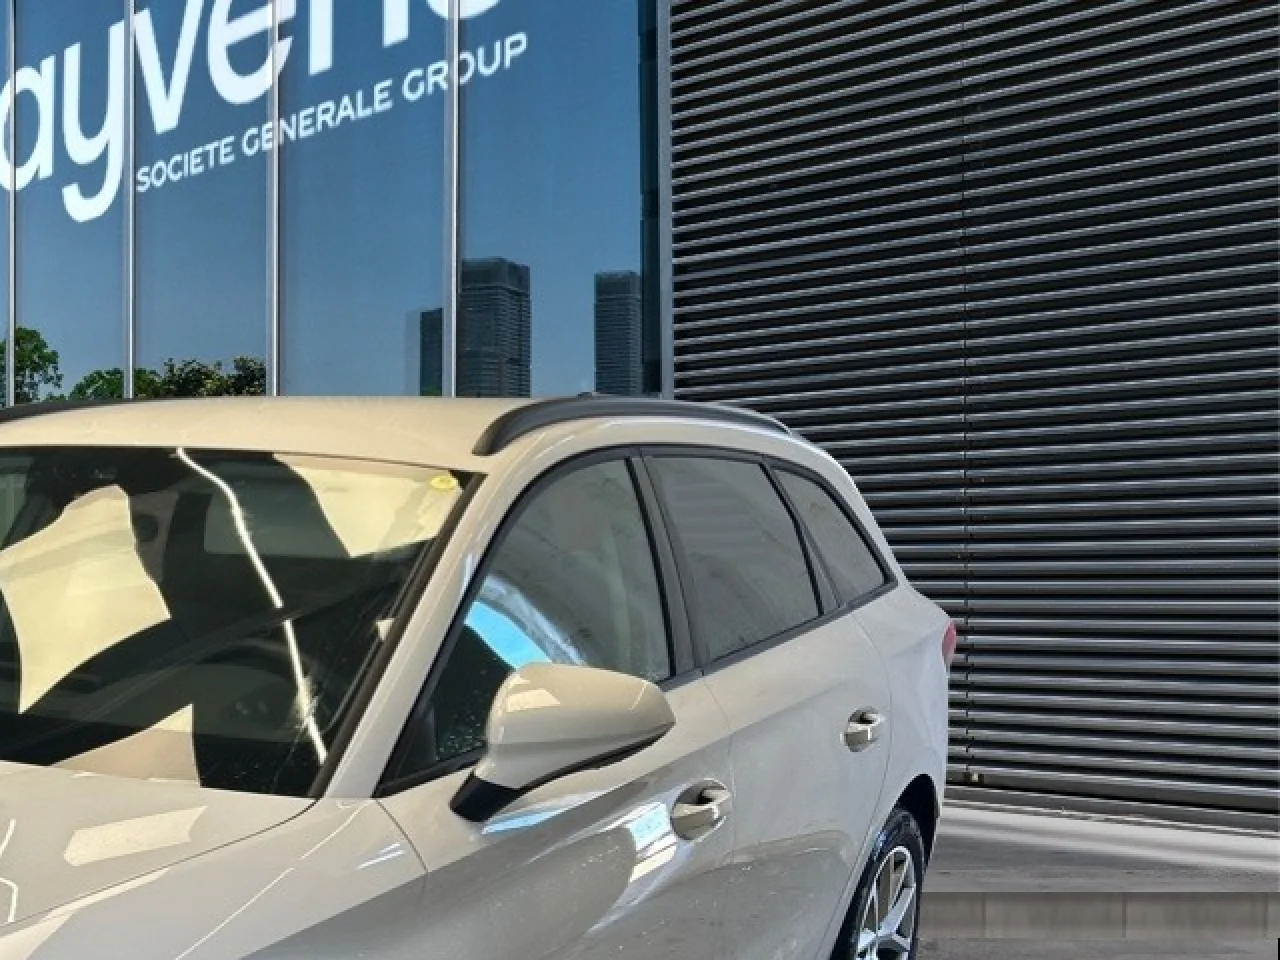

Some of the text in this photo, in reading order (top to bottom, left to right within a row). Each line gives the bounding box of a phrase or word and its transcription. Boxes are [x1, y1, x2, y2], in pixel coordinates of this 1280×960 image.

[136, 32, 528, 192] SOCIETE GENERALE GROUP
